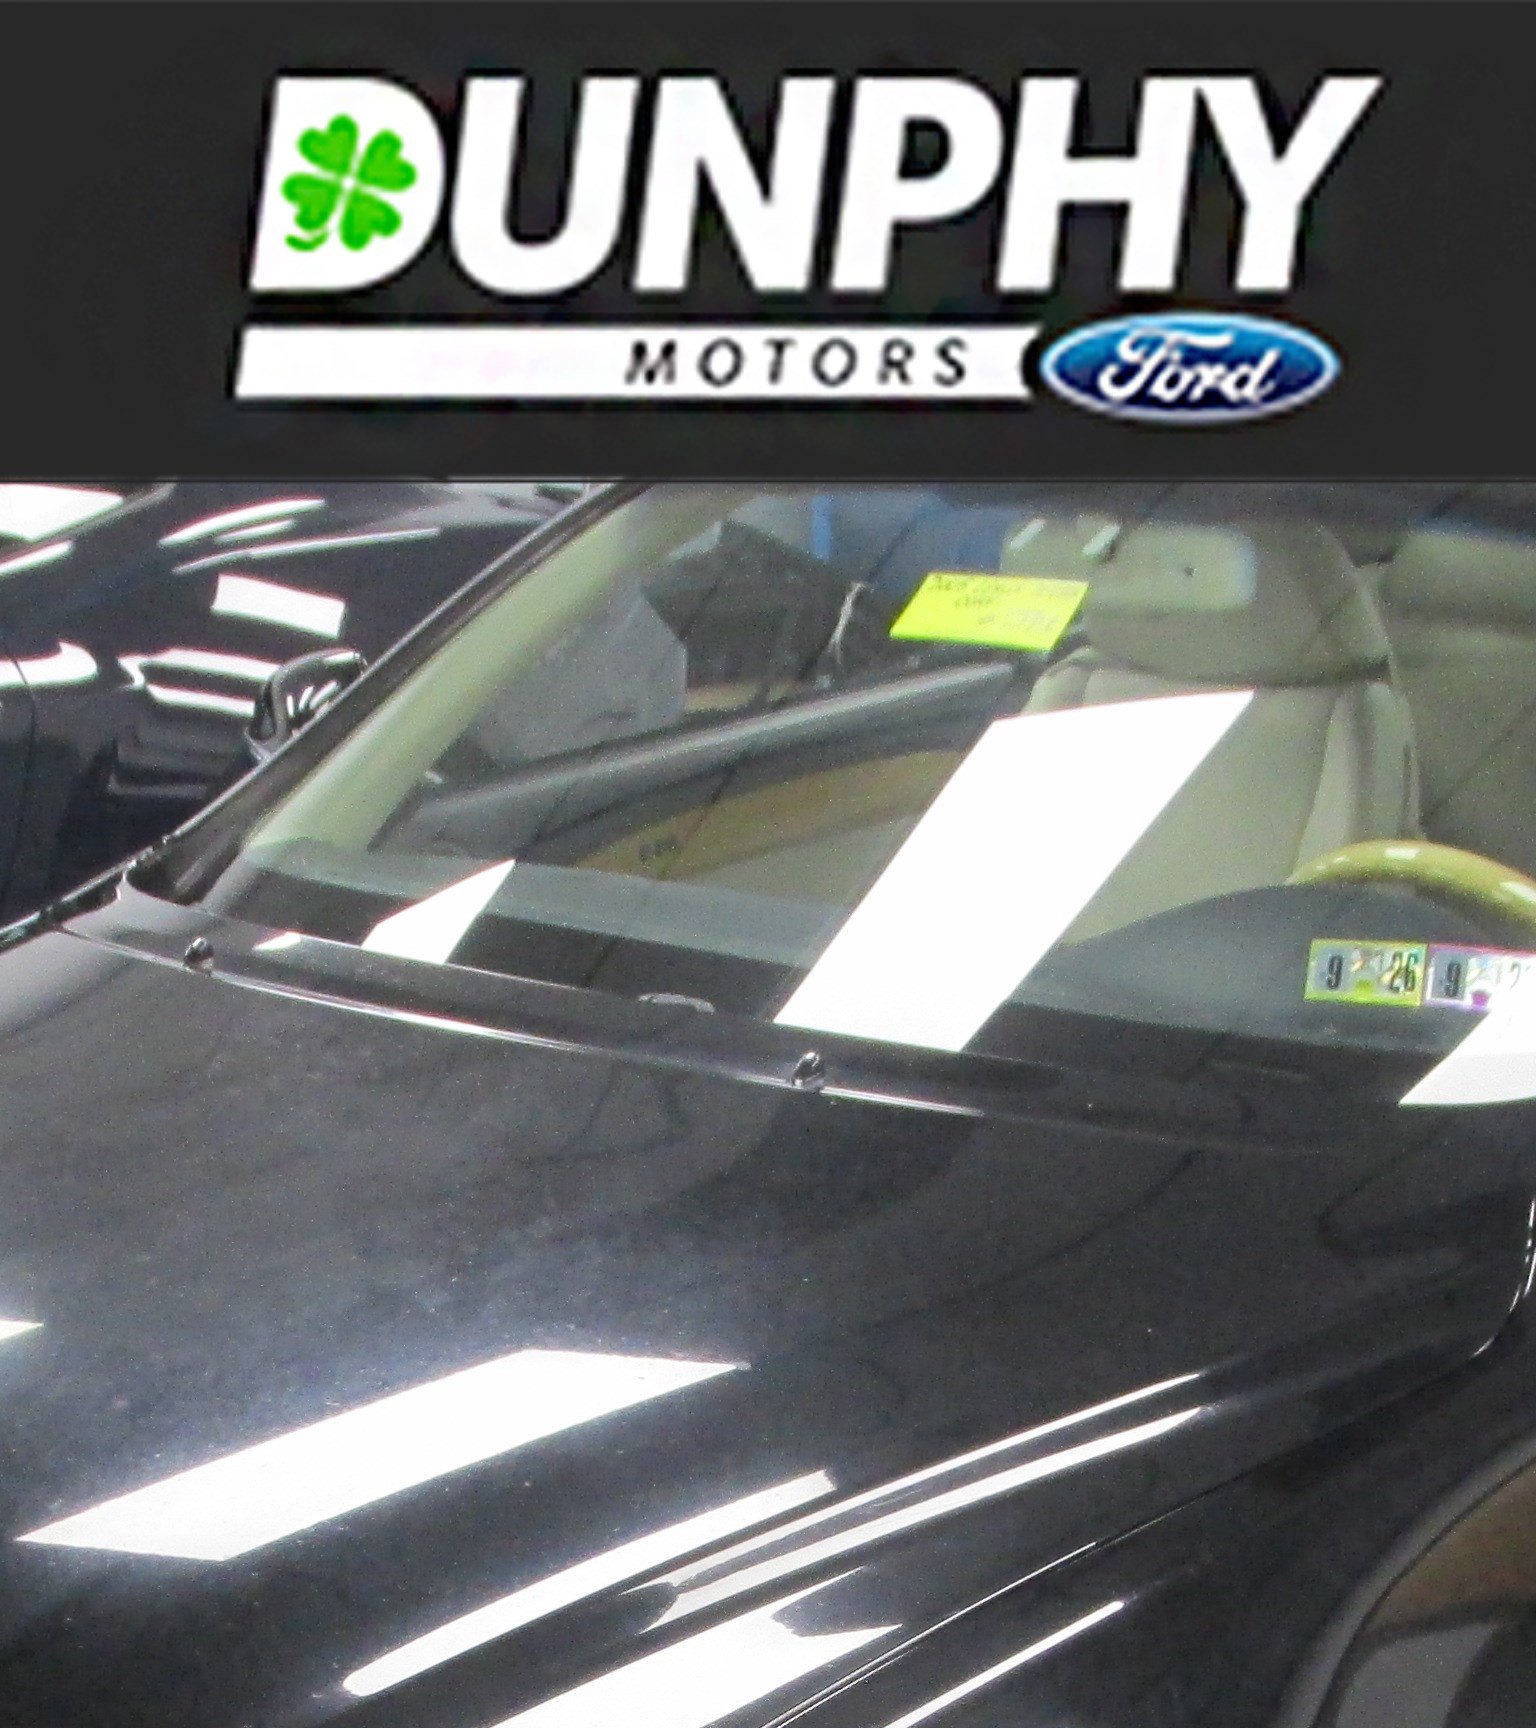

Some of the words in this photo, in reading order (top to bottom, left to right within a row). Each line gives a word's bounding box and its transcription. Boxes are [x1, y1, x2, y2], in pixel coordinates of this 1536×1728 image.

[1326, 954, 1345, 990] 9
[1389, 950, 1419, 994] 26
[1444, 959, 1463, 999] 9
